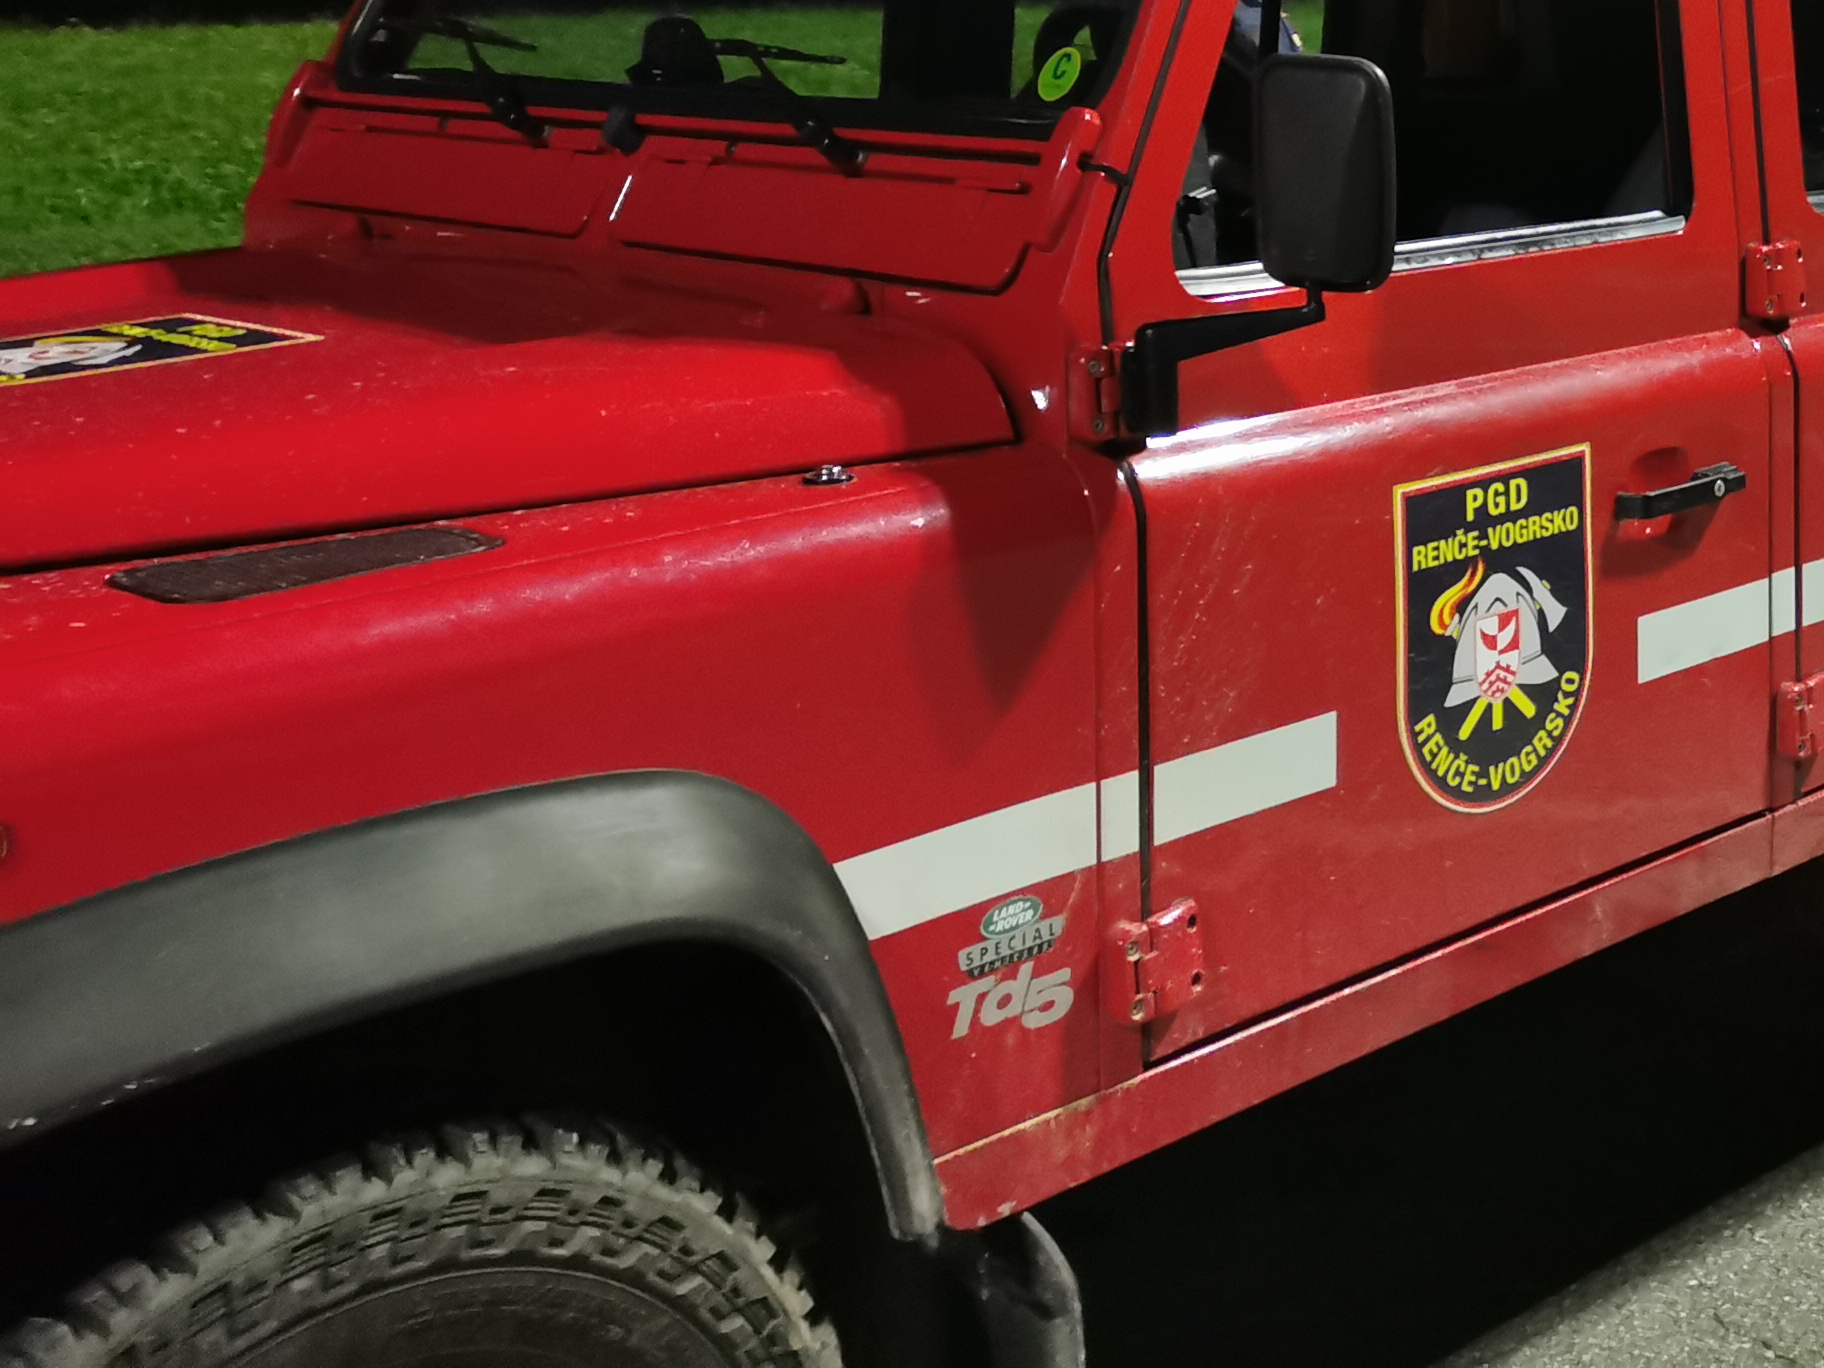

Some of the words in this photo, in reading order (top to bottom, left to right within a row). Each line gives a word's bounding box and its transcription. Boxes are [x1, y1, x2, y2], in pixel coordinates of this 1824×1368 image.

[1052, 52, 1073, 80] C
[1465, 477, 1529, 522] PGD
[1411, 505, 1579, 572] RENČE-VOGRSKO
[1414, 669, 1581, 794] RENČE-VOGRSKO
[965, 922, 1056, 967] SPECIAL
[947, 960, 1074, 1040] Td5
